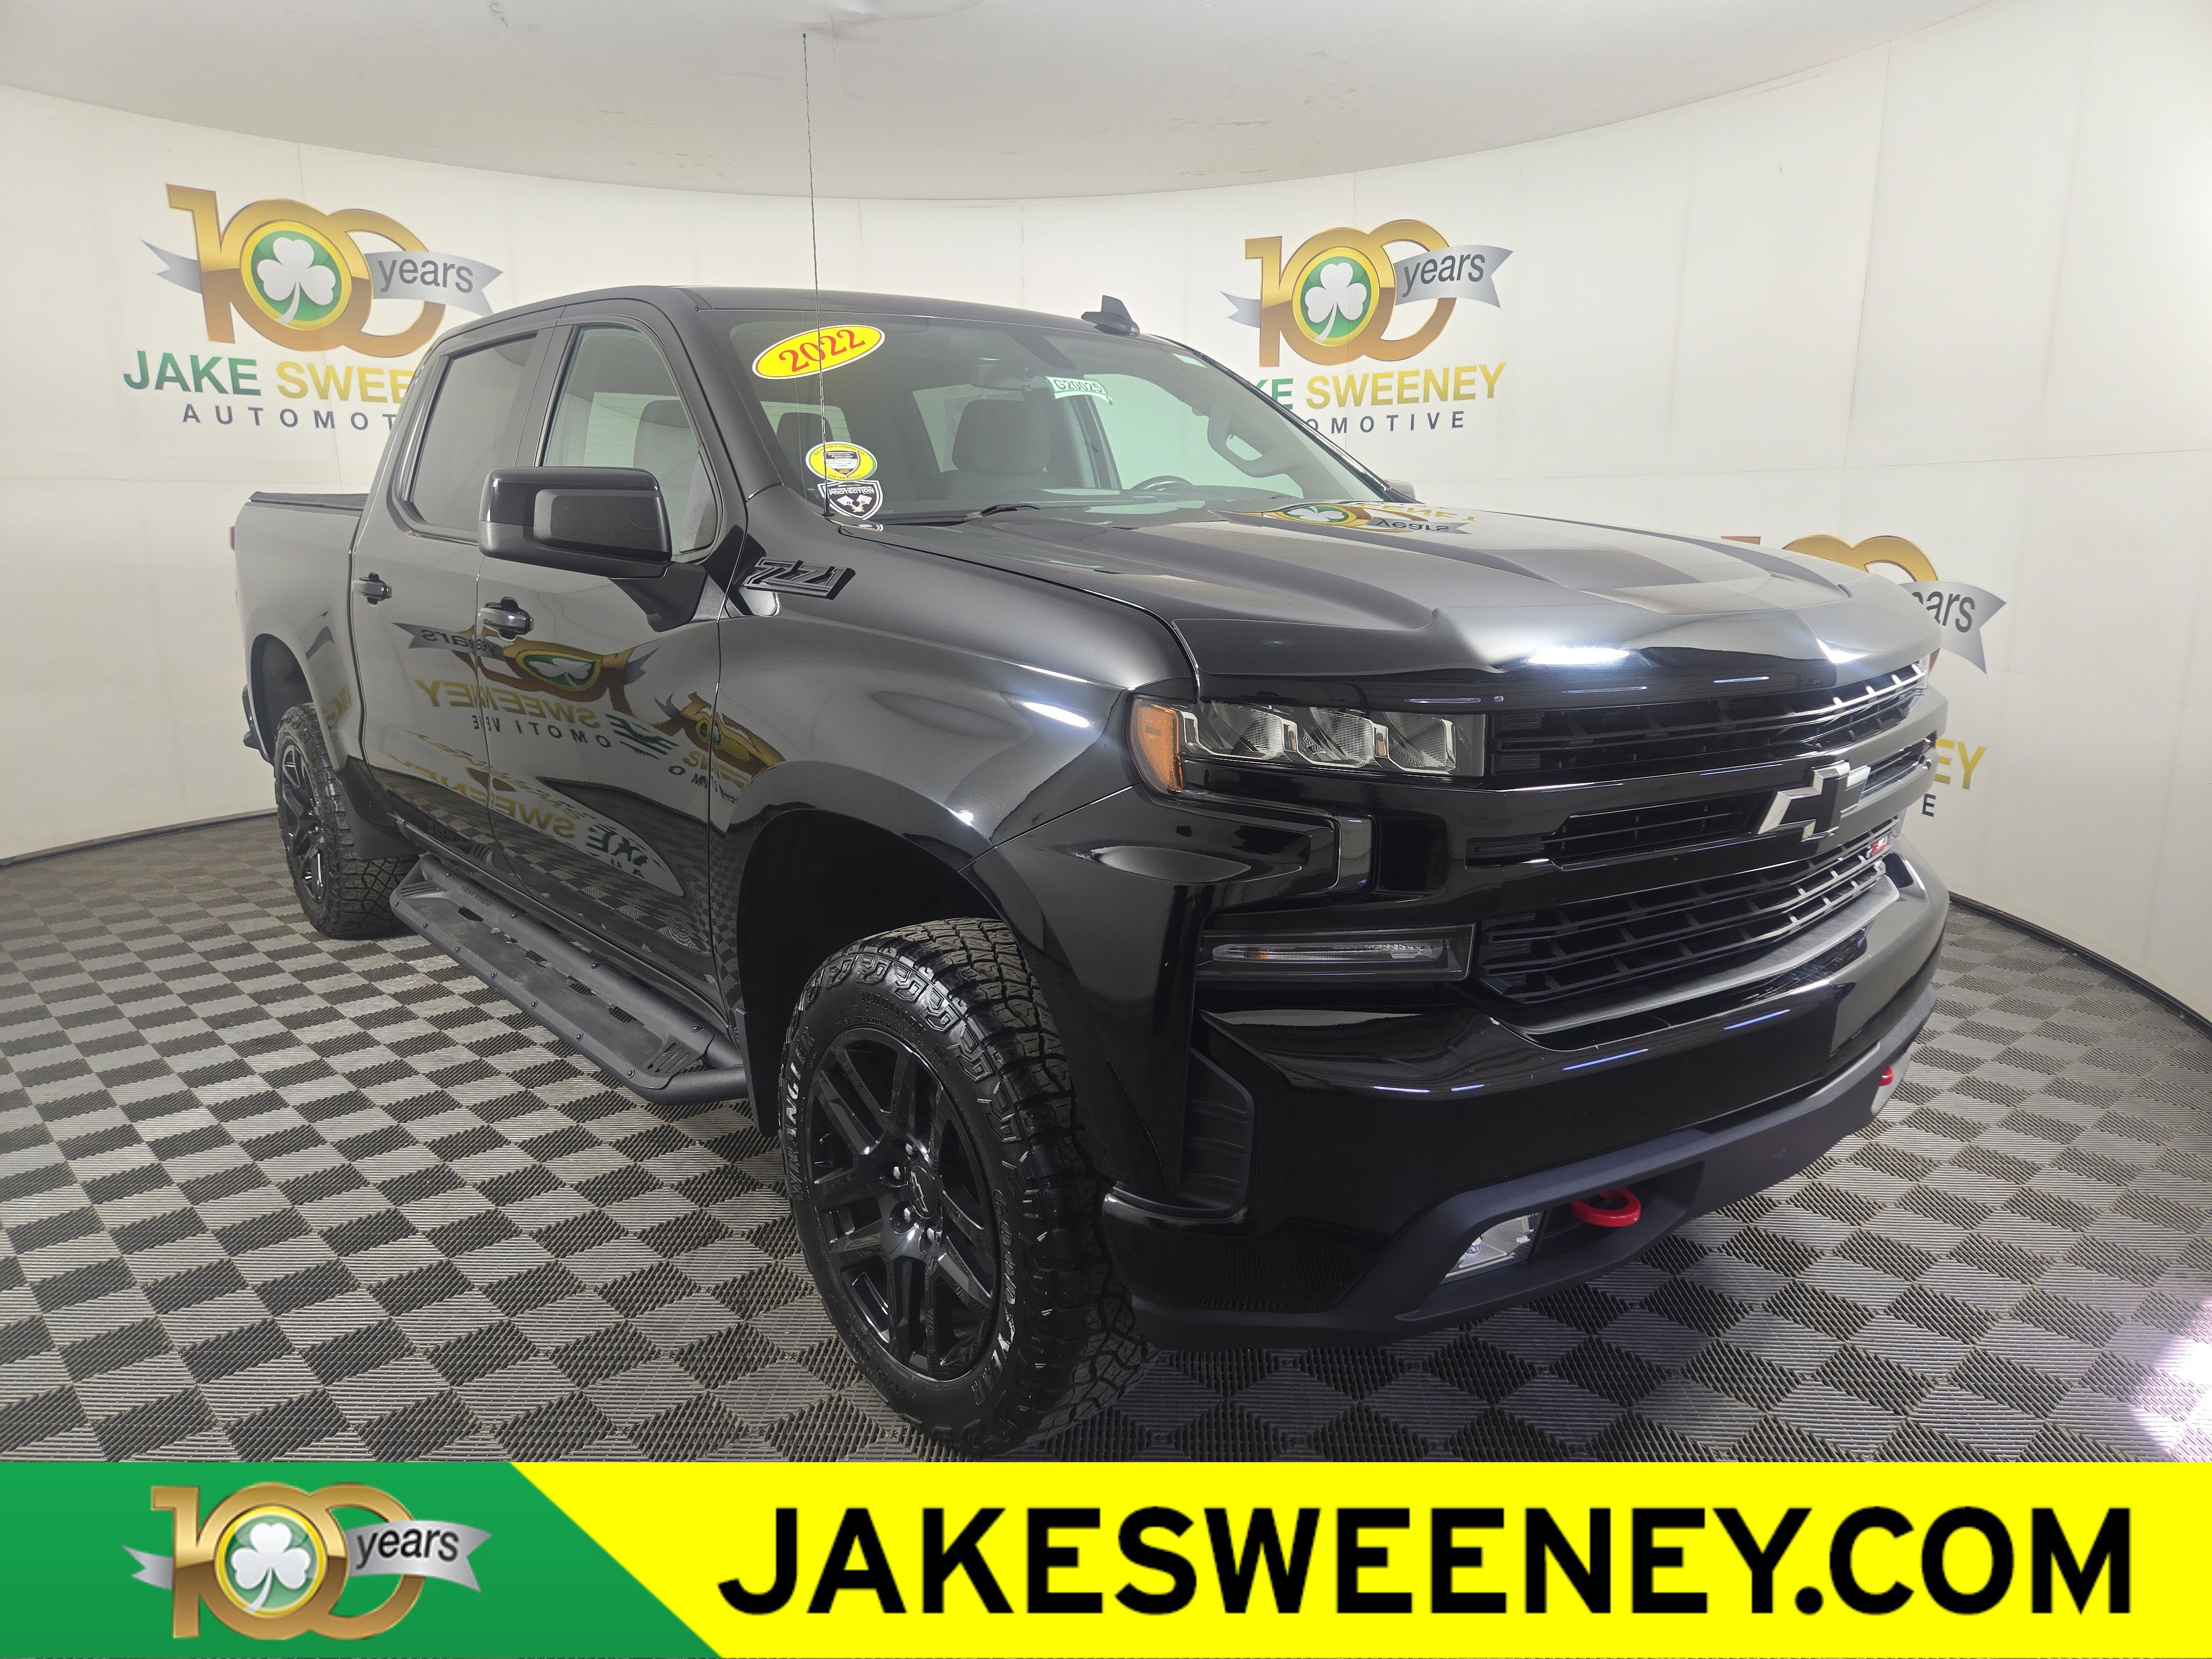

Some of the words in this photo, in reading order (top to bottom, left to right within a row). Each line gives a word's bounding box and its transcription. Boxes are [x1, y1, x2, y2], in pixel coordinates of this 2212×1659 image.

[165, 183, 446, 358] 100
[378, 259, 474, 293] years
[1245, 219, 1457, 368] 100
[1403, 254, 1486, 298] years
[779, 329, 866, 372] 2022
[123, 350, 261, 396] JAKE
[276, 361, 415, 404] SWEE
[1053, 380, 1103, 393] G20025
[1306, 363, 1507, 410] SWEENEY
[182, 404, 397, 430] AUTOMOT
